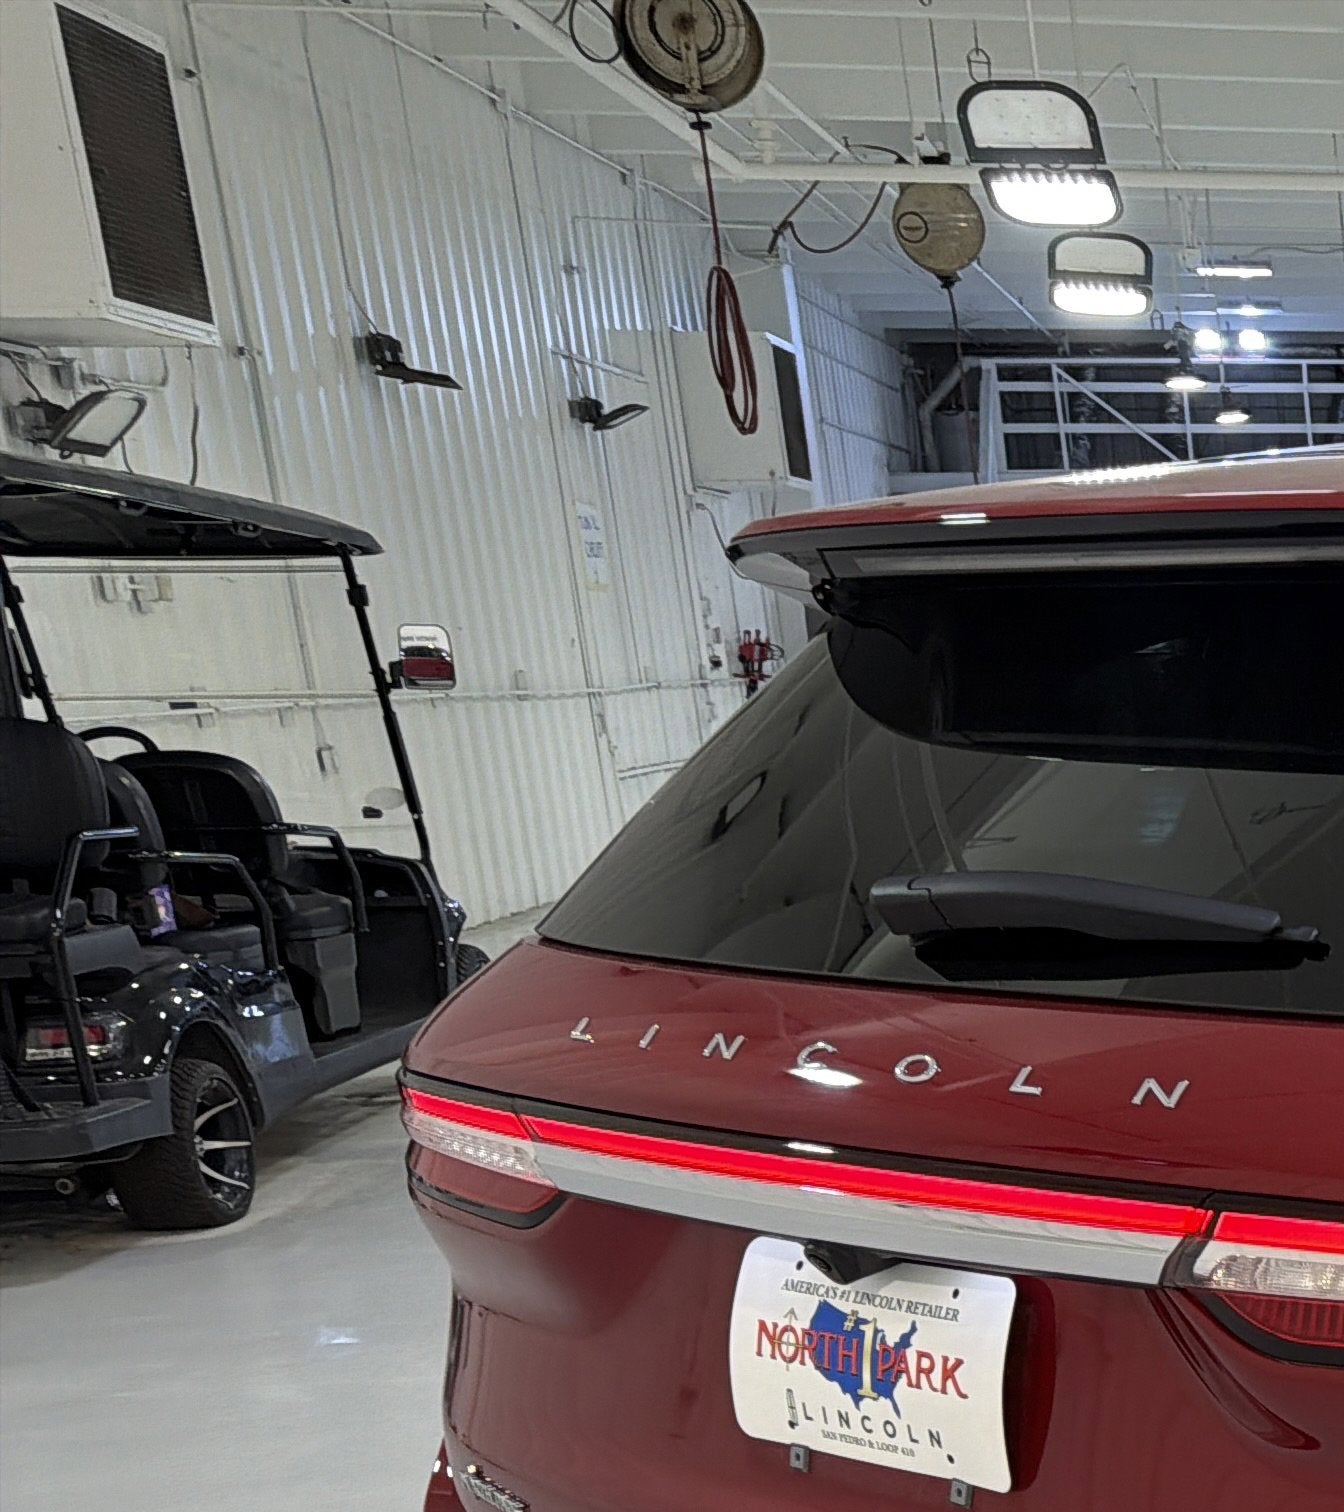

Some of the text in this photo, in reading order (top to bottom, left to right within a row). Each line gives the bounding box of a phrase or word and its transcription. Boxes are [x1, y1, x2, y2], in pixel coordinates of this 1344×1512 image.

[569, 1015, 1191, 1110] LINCOLN
[781, 1278, 960, 1321] AMERICA'S #1 LINCOLN RETAILER
[756, 1319, 969, 1399] NORTH PARK
[801, 1401, 943, 1449] LINCOLN
